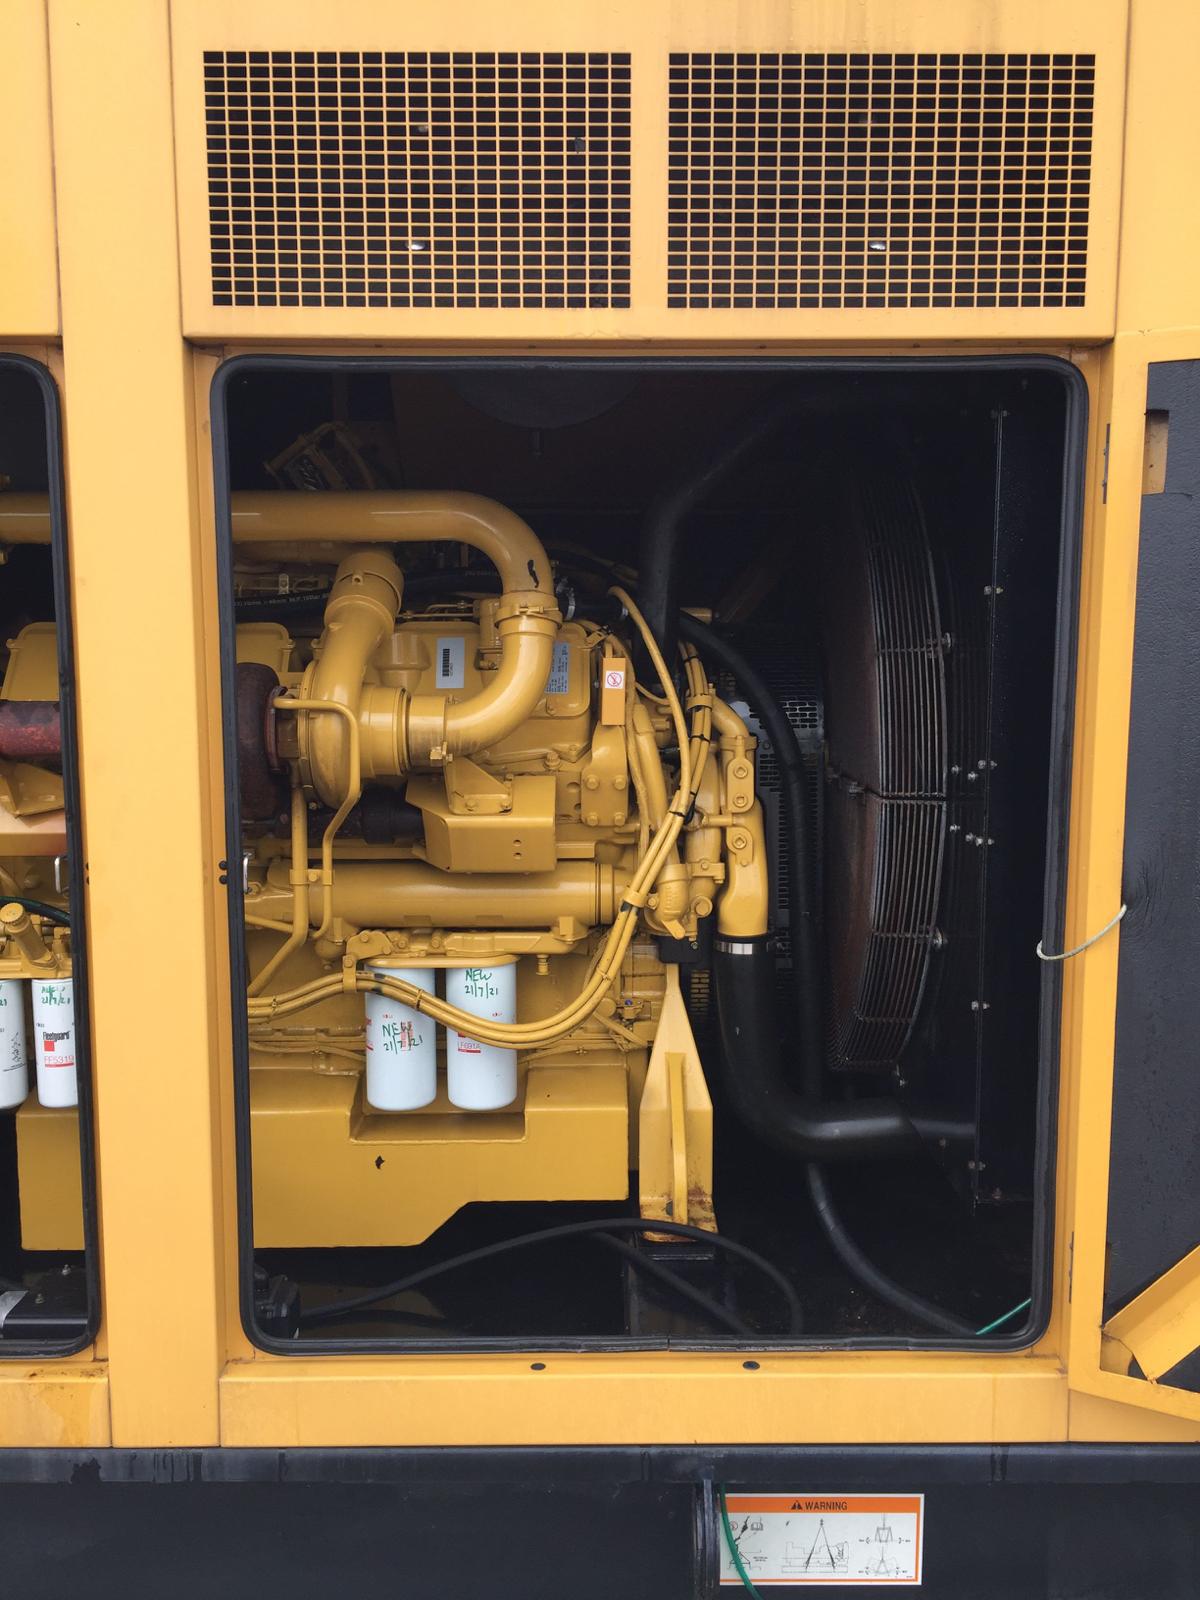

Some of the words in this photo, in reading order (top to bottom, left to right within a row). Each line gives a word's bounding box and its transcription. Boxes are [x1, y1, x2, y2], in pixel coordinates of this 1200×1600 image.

[465, 968, 493, 981] NEW
[464, 982, 499, 999] 21/7/21
[382, 1021, 413, 1037] NEW
[42, 1031, 71, 1043] Fleetguard
[383, 1035, 424, 1055] 21/7/21
[804, 1501, 848, 1511] WARNING
